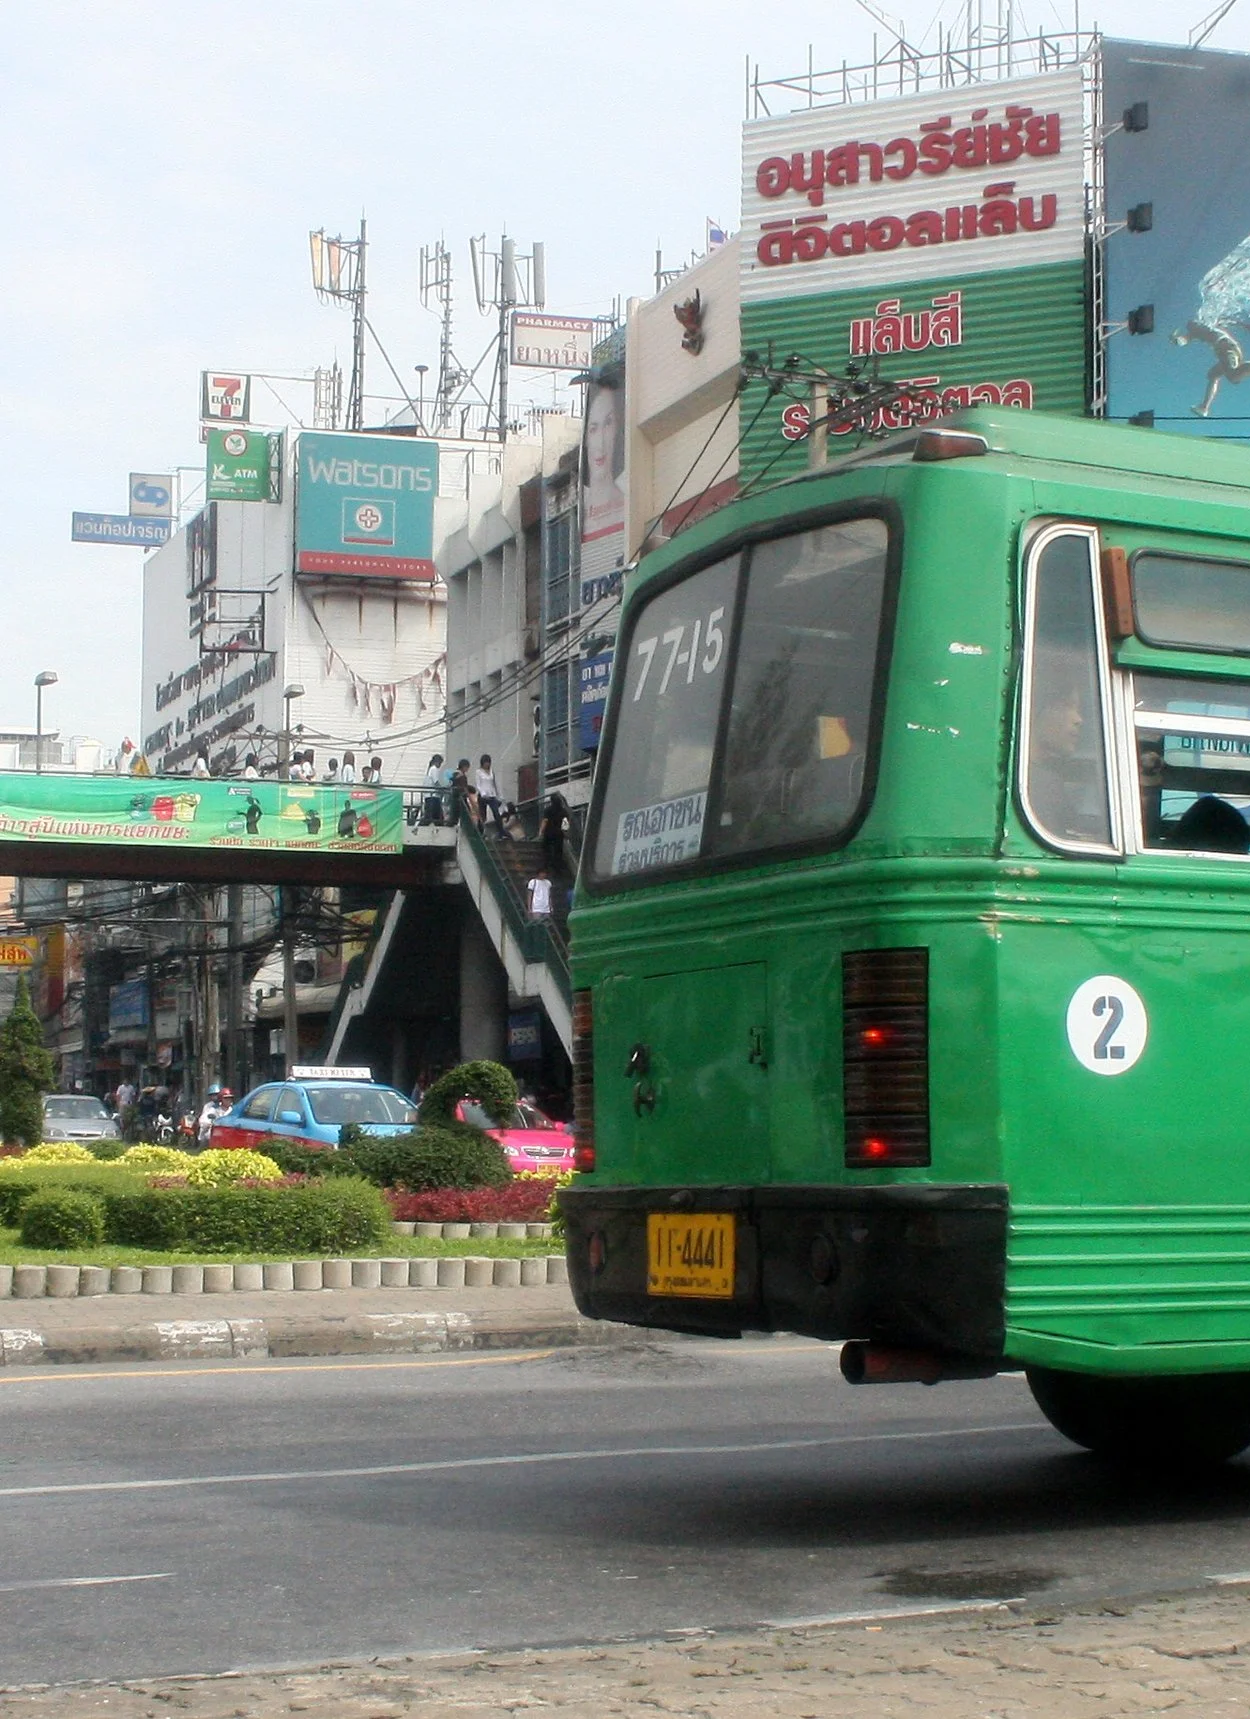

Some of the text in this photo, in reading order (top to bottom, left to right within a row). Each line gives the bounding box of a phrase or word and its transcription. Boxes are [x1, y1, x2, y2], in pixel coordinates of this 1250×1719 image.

[756, 106, 1060, 206] อนุสาวรีย์ชัย
[757, 182, 1057, 266] ดิจิตอลแล็บ
[517, 317, 589, 329] PHARMACY
[517, 335, 589, 366] ยาหนึ่ง
[849, 291, 962, 357] แล็บสี
[212, 377, 241, 417] 7
[234, 469, 258, 478] ATM
[634, 606, 724, 701] 77-15
[1092, 995, 1125, 1059] 2
